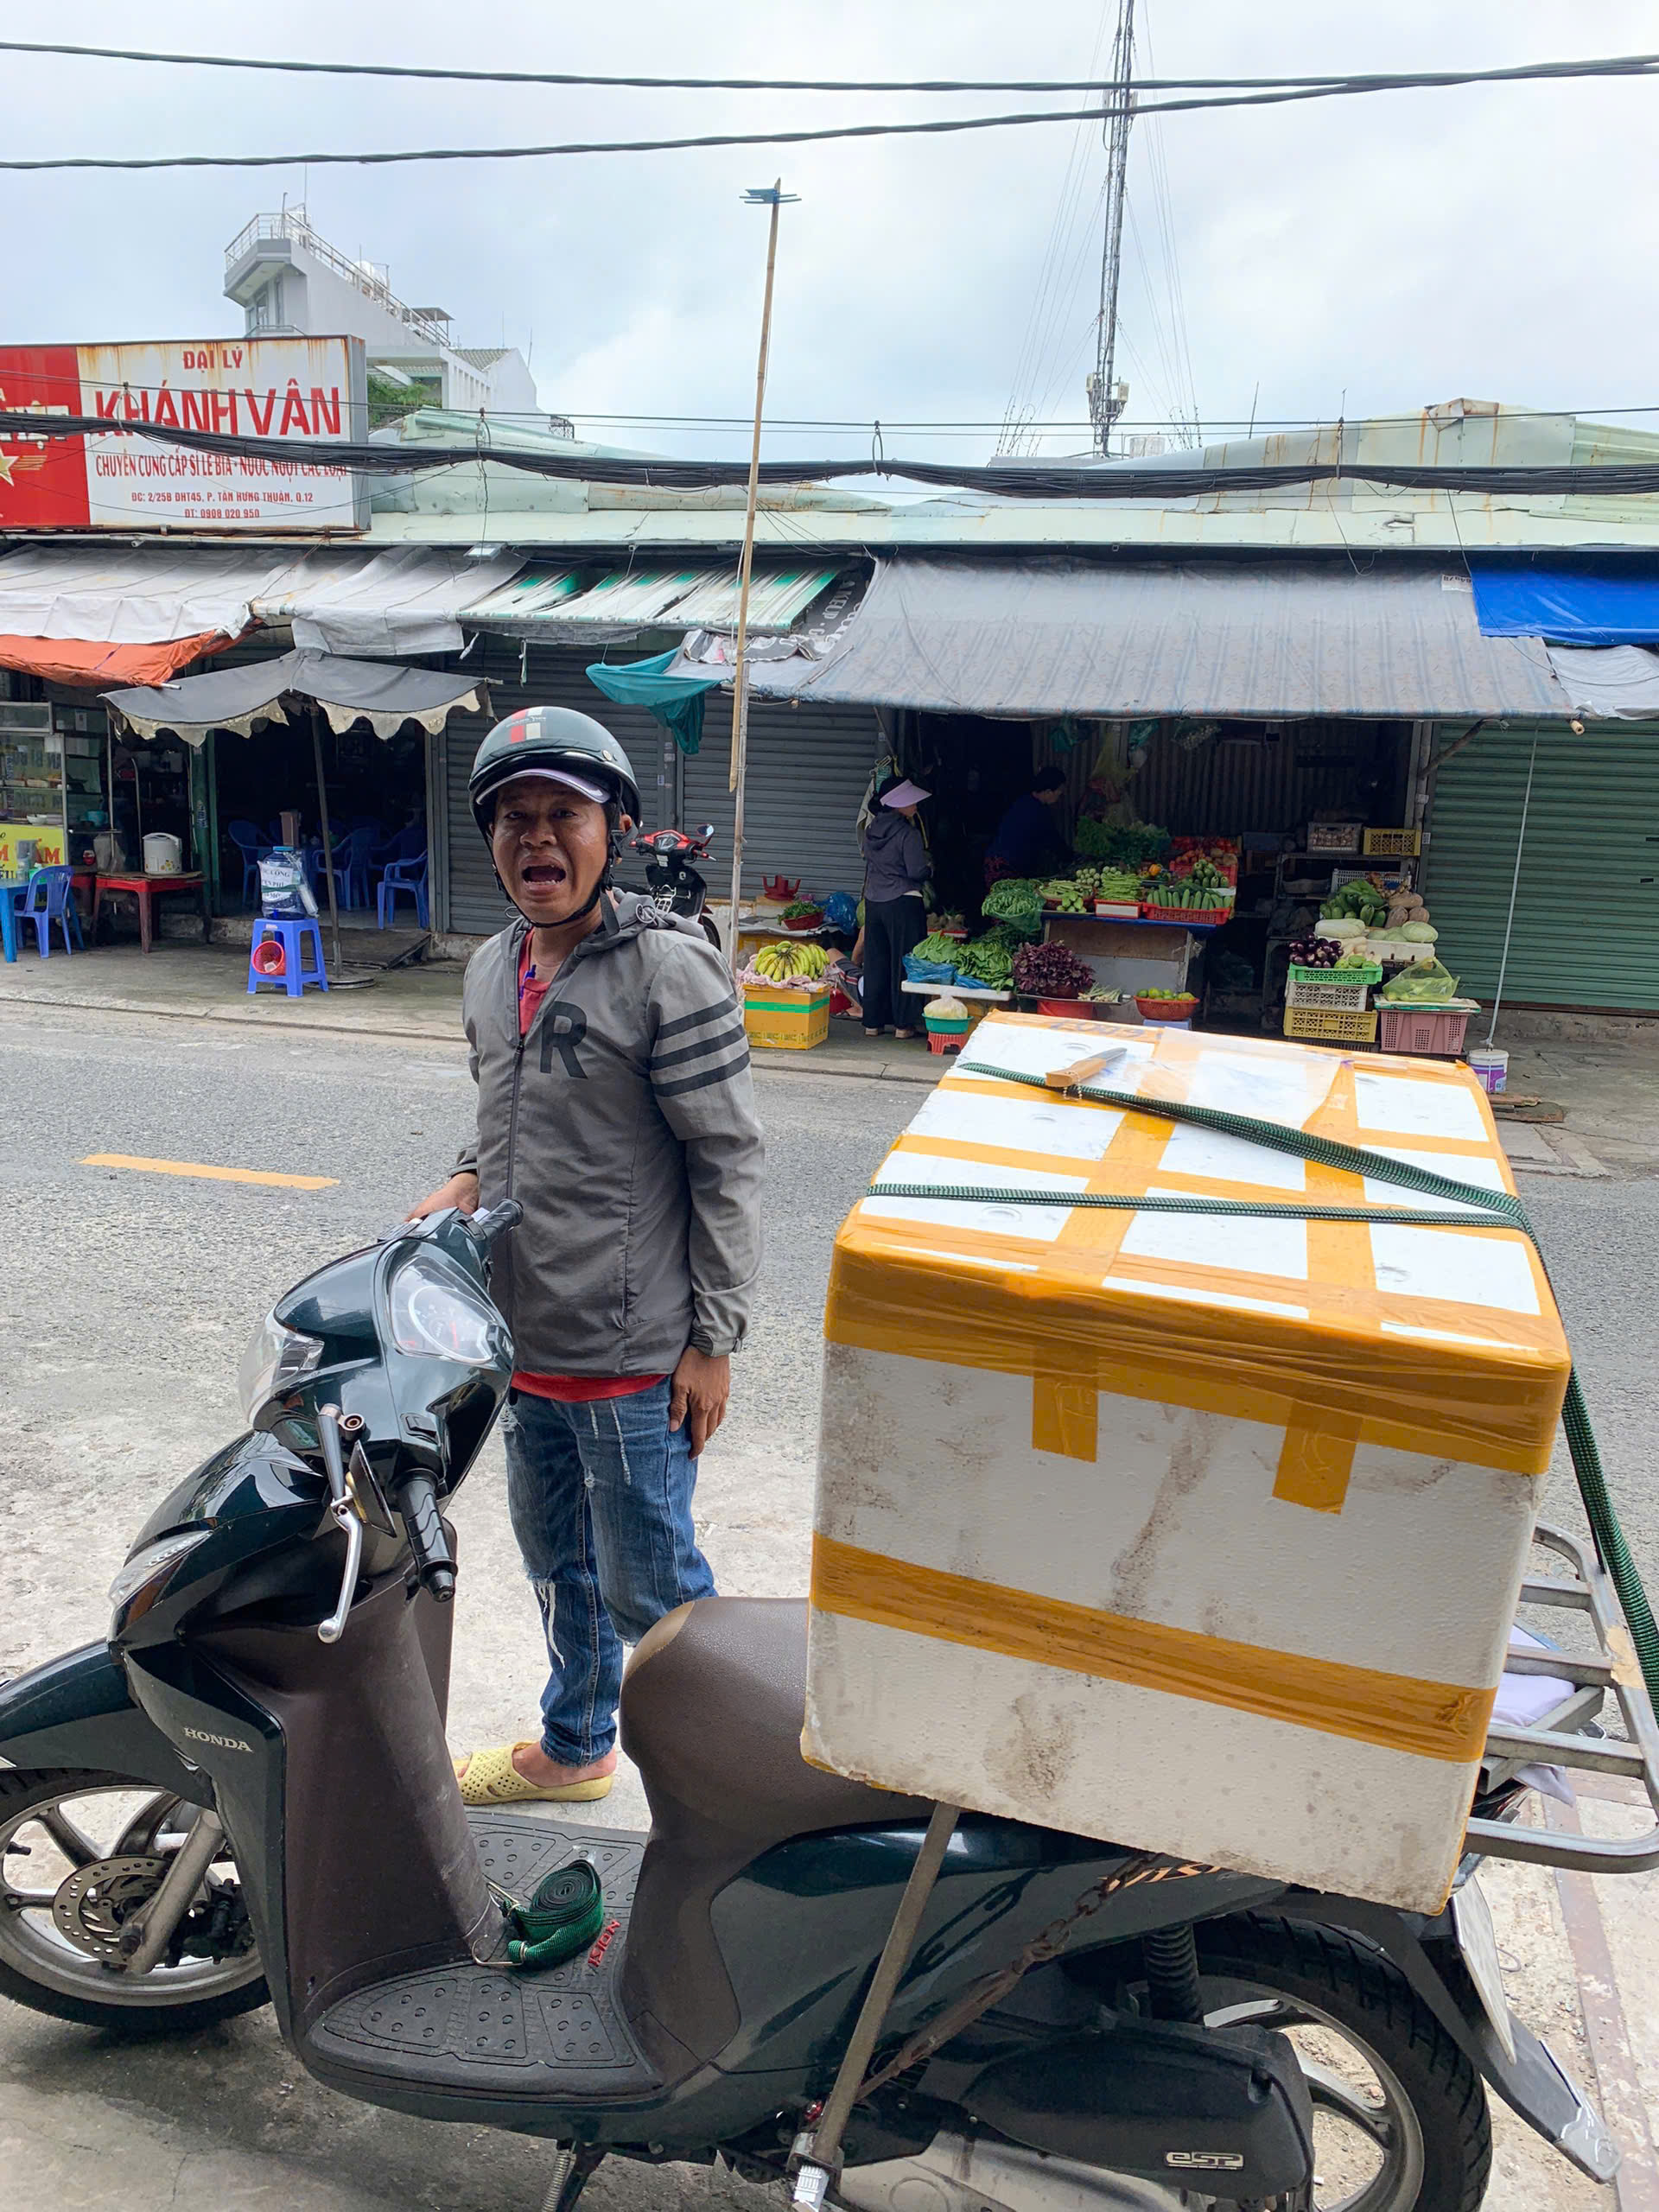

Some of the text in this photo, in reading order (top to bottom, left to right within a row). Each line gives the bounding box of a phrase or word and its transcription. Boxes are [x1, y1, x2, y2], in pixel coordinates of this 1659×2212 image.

[182, 346, 243, 373] ĐẠI LÝ
[95, 379, 238, 436] KHÁNH
[244, 378, 340, 435] VÂN
[138, 454, 166, 477] CUNG
[148, 492, 172, 502] 2/25B
[207, 492, 215, 502] P.
[200, 508, 222, 518] 0908
[225, 508, 240, 518] 020
[244, 508, 260, 518] 950
[539, 1001, 588, 1079] R
[184, 1727, 254, 1753] HONDA
[585, 1921, 620, 1977] VISION
